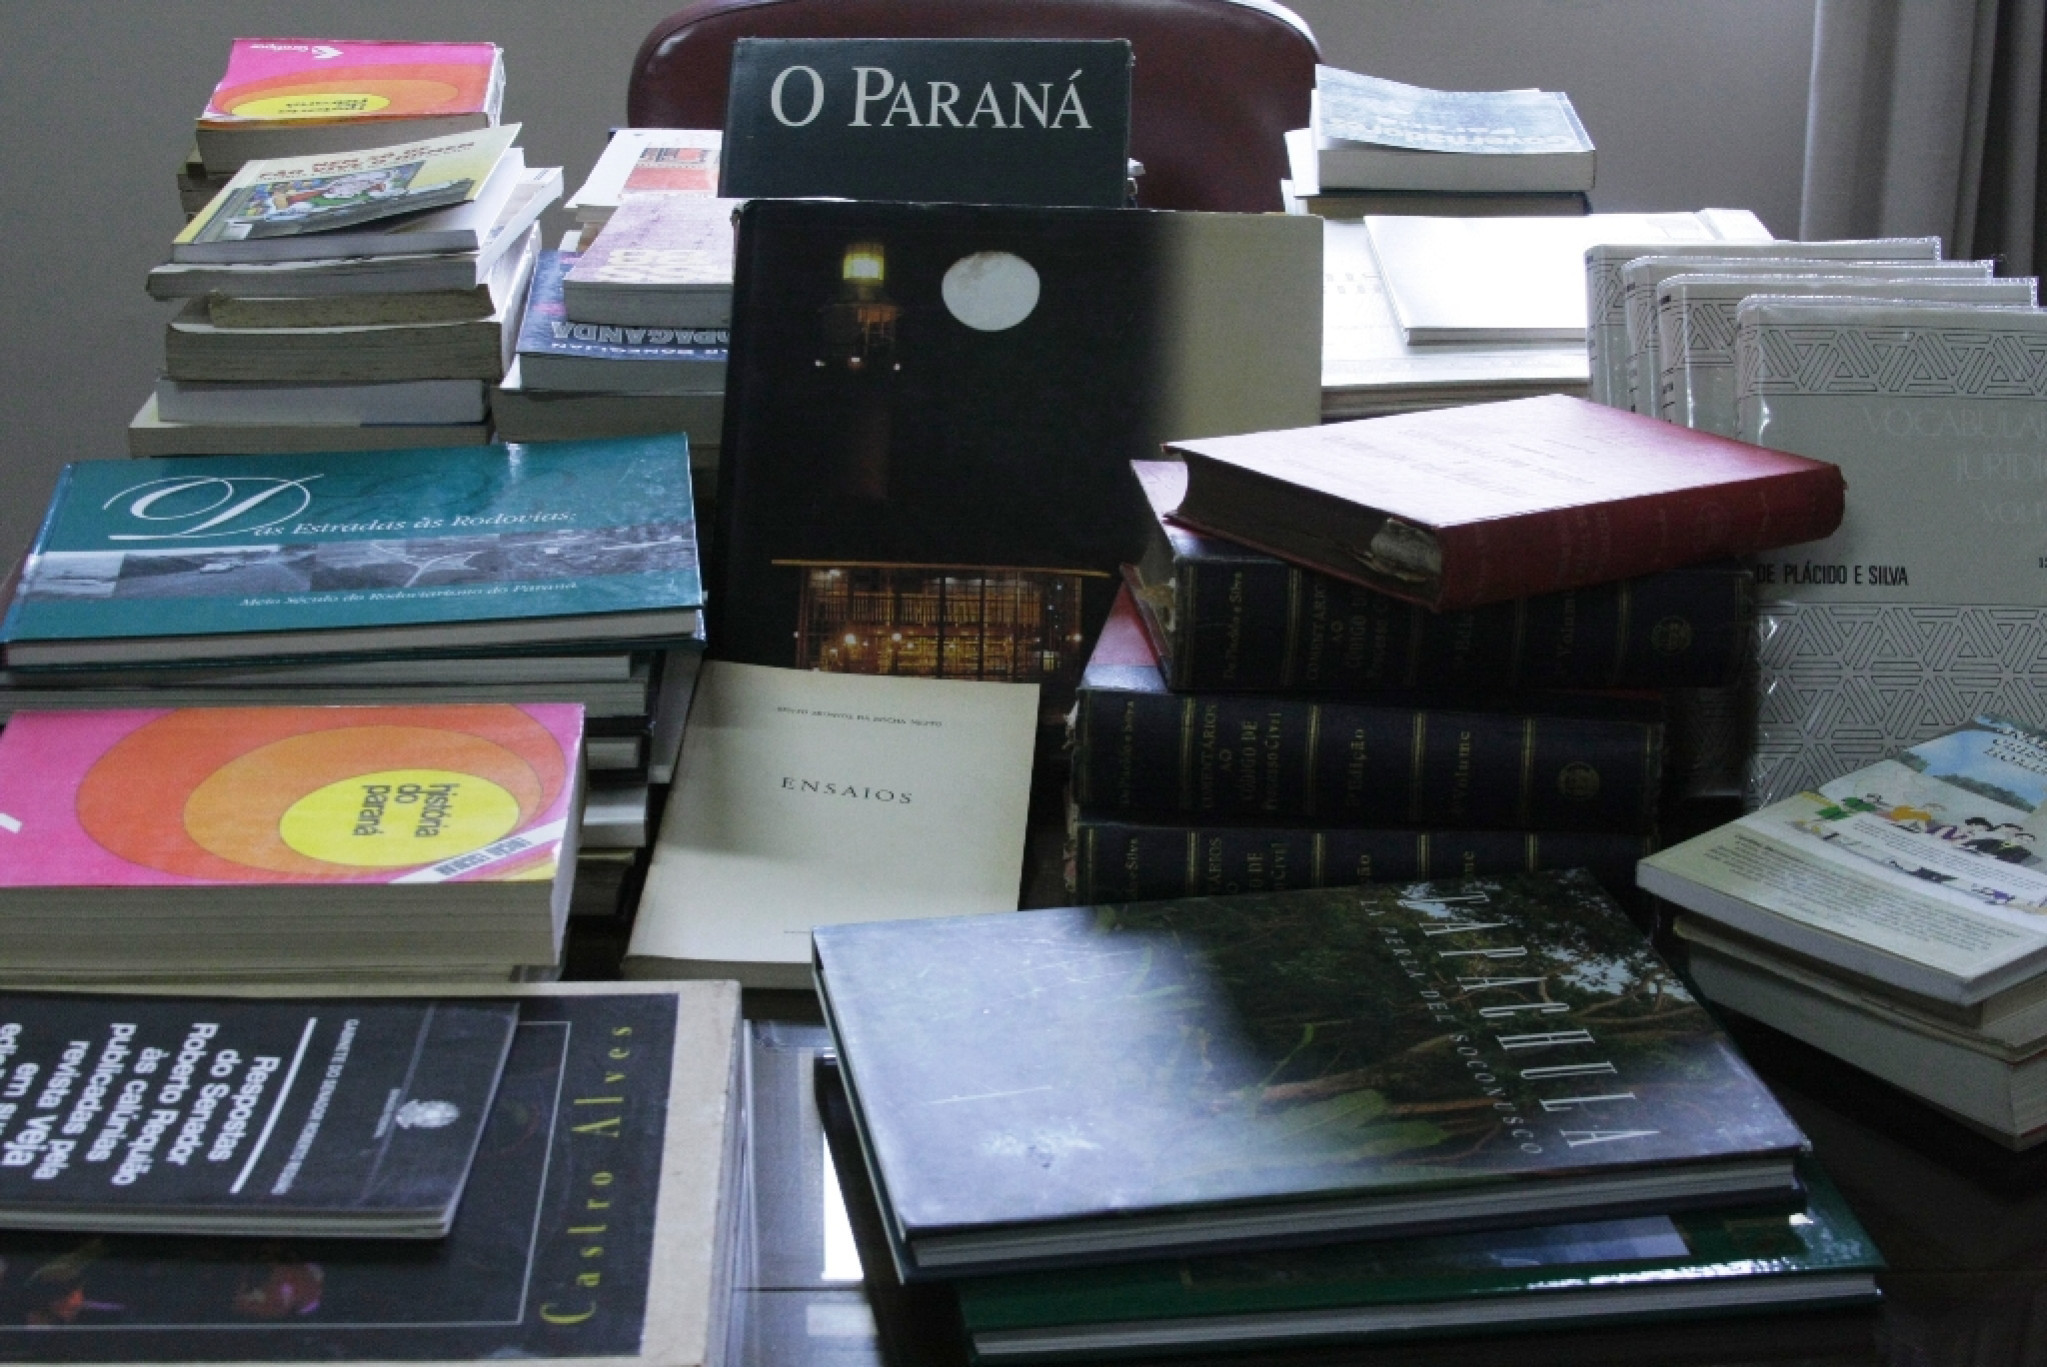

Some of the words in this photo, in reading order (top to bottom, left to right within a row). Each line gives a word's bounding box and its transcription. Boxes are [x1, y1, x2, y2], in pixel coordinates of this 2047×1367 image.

[771, 65, 824, 127] O
[1861, 404, 2047, 440] VOCABULA
[293, 514, 406, 537] Estradas
[420, 509, 445, 530] às
[1756, 564, 1775, 584] DE
[1785, 560, 1848, 585] PLÁCIDO
[1854, 564, 1863, 585] E
[1869, 565, 1910, 587] SILVA
[1240, 720, 1259, 741] DE
[352, 784, 391, 837] paraná
[395, 783, 422, 804] do
[415, 782, 460, 838] história
[781, 776, 913, 804] ENSAIOS
[1397, 890, 1661, 1147] TAPACHULA
[1, 1062, 40, 1098] em
[35, 1039, 92, 1109] revista
[61, 1022, 139, 1135] publicadas
[133, 1046, 171, 1074] às
[158, 1022, 220, 1104] Roberto
[210, 1048, 243, 1078] do
[571, 1025, 633, 1139] Alves
[1420, 989, 1456, 1022] DEL
[1450, 1033, 1544, 1154] SOCONUSCO
[85, 1078, 149, 1162] calúnias
[165, 1082, 231, 1166] Senador
[207, 1055, 282, 1162] Respostas
[32, 1138, 78, 1180] pela
[111, 1108, 181, 1186] Requião
[539, 1170, 615, 1325] Castro
